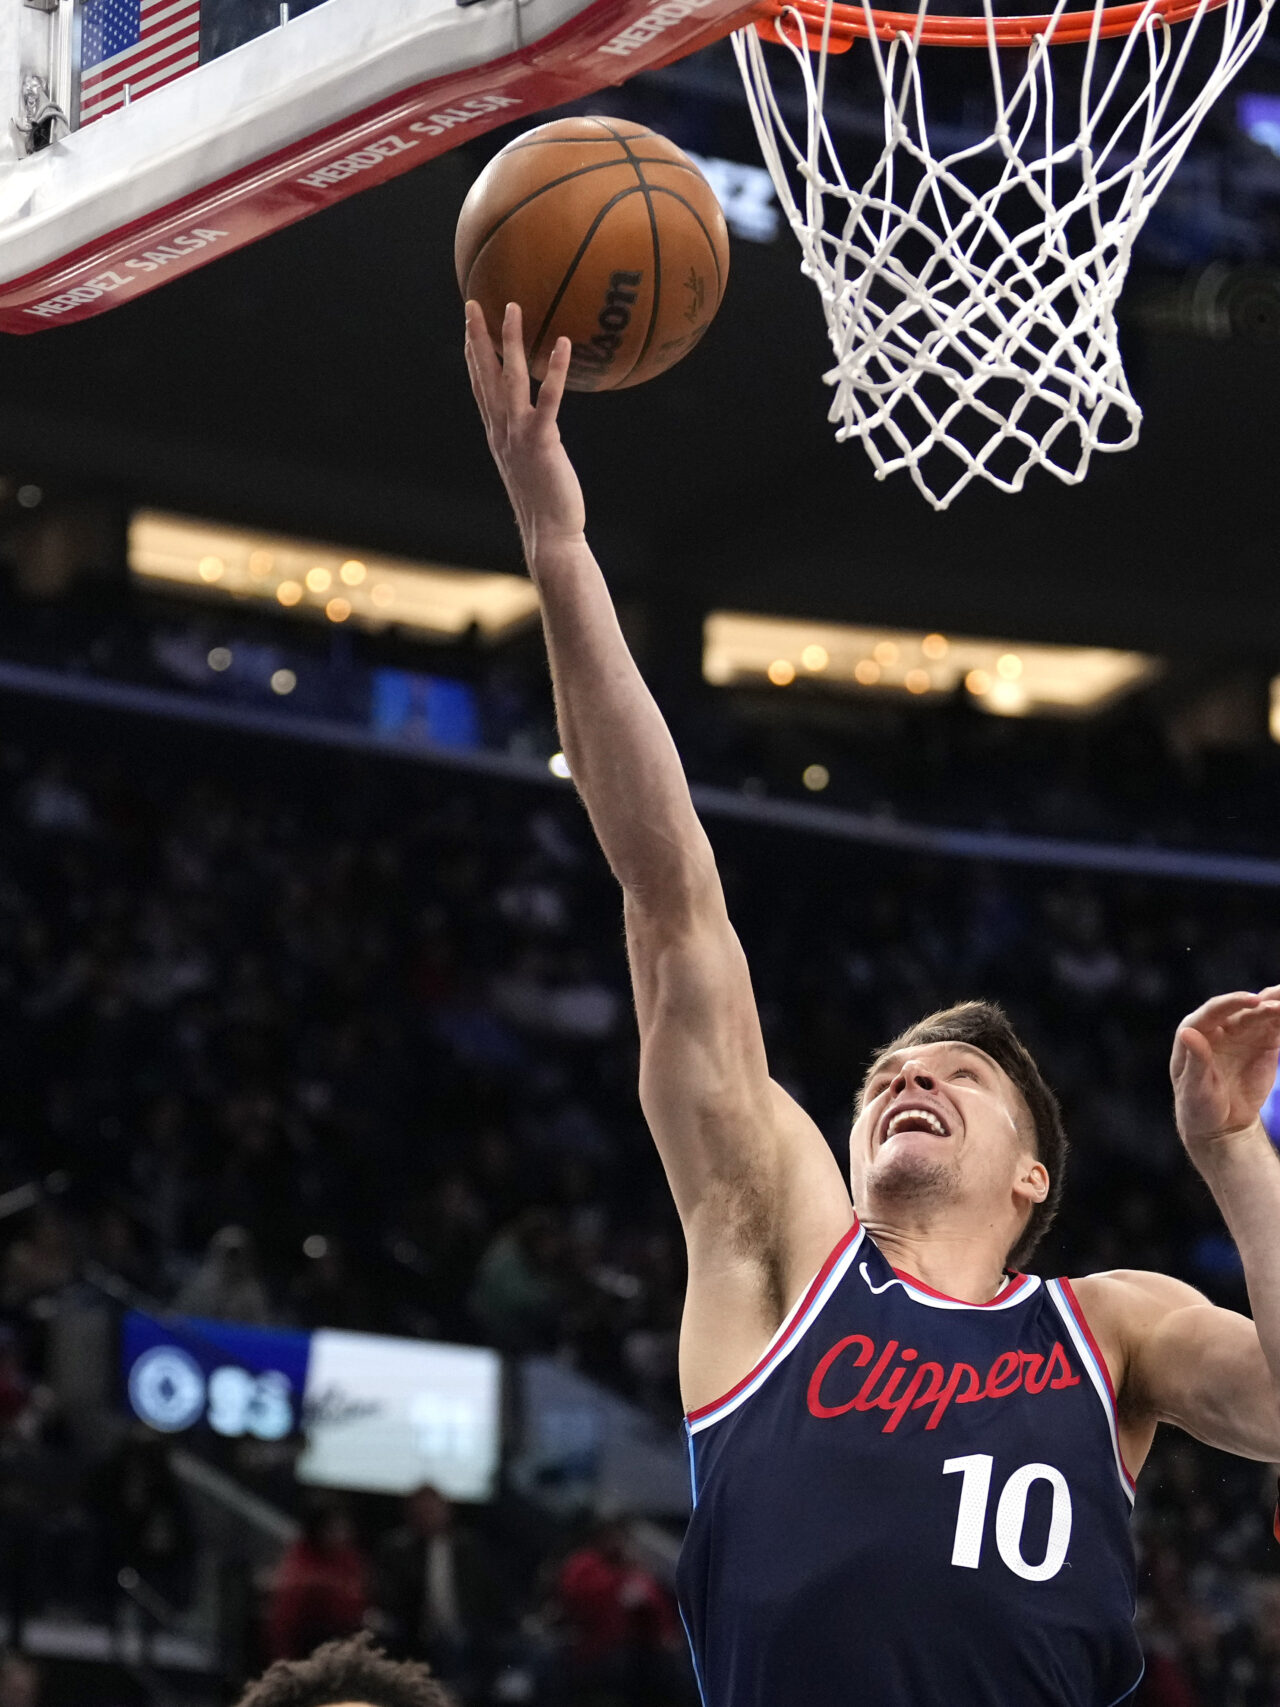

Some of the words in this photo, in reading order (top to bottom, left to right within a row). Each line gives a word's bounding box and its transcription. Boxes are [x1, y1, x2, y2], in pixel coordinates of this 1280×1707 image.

[297, 134, 420, 188] HERDEZ
[409, 95, 524, 136] SALSA
[22, 270, 136, 317] HERDEZ
[125, 228, 230, 272] SALSA
[806, 1334, 1080, 1433] Clippers
[942, 1453, 1073, 1582] 10
